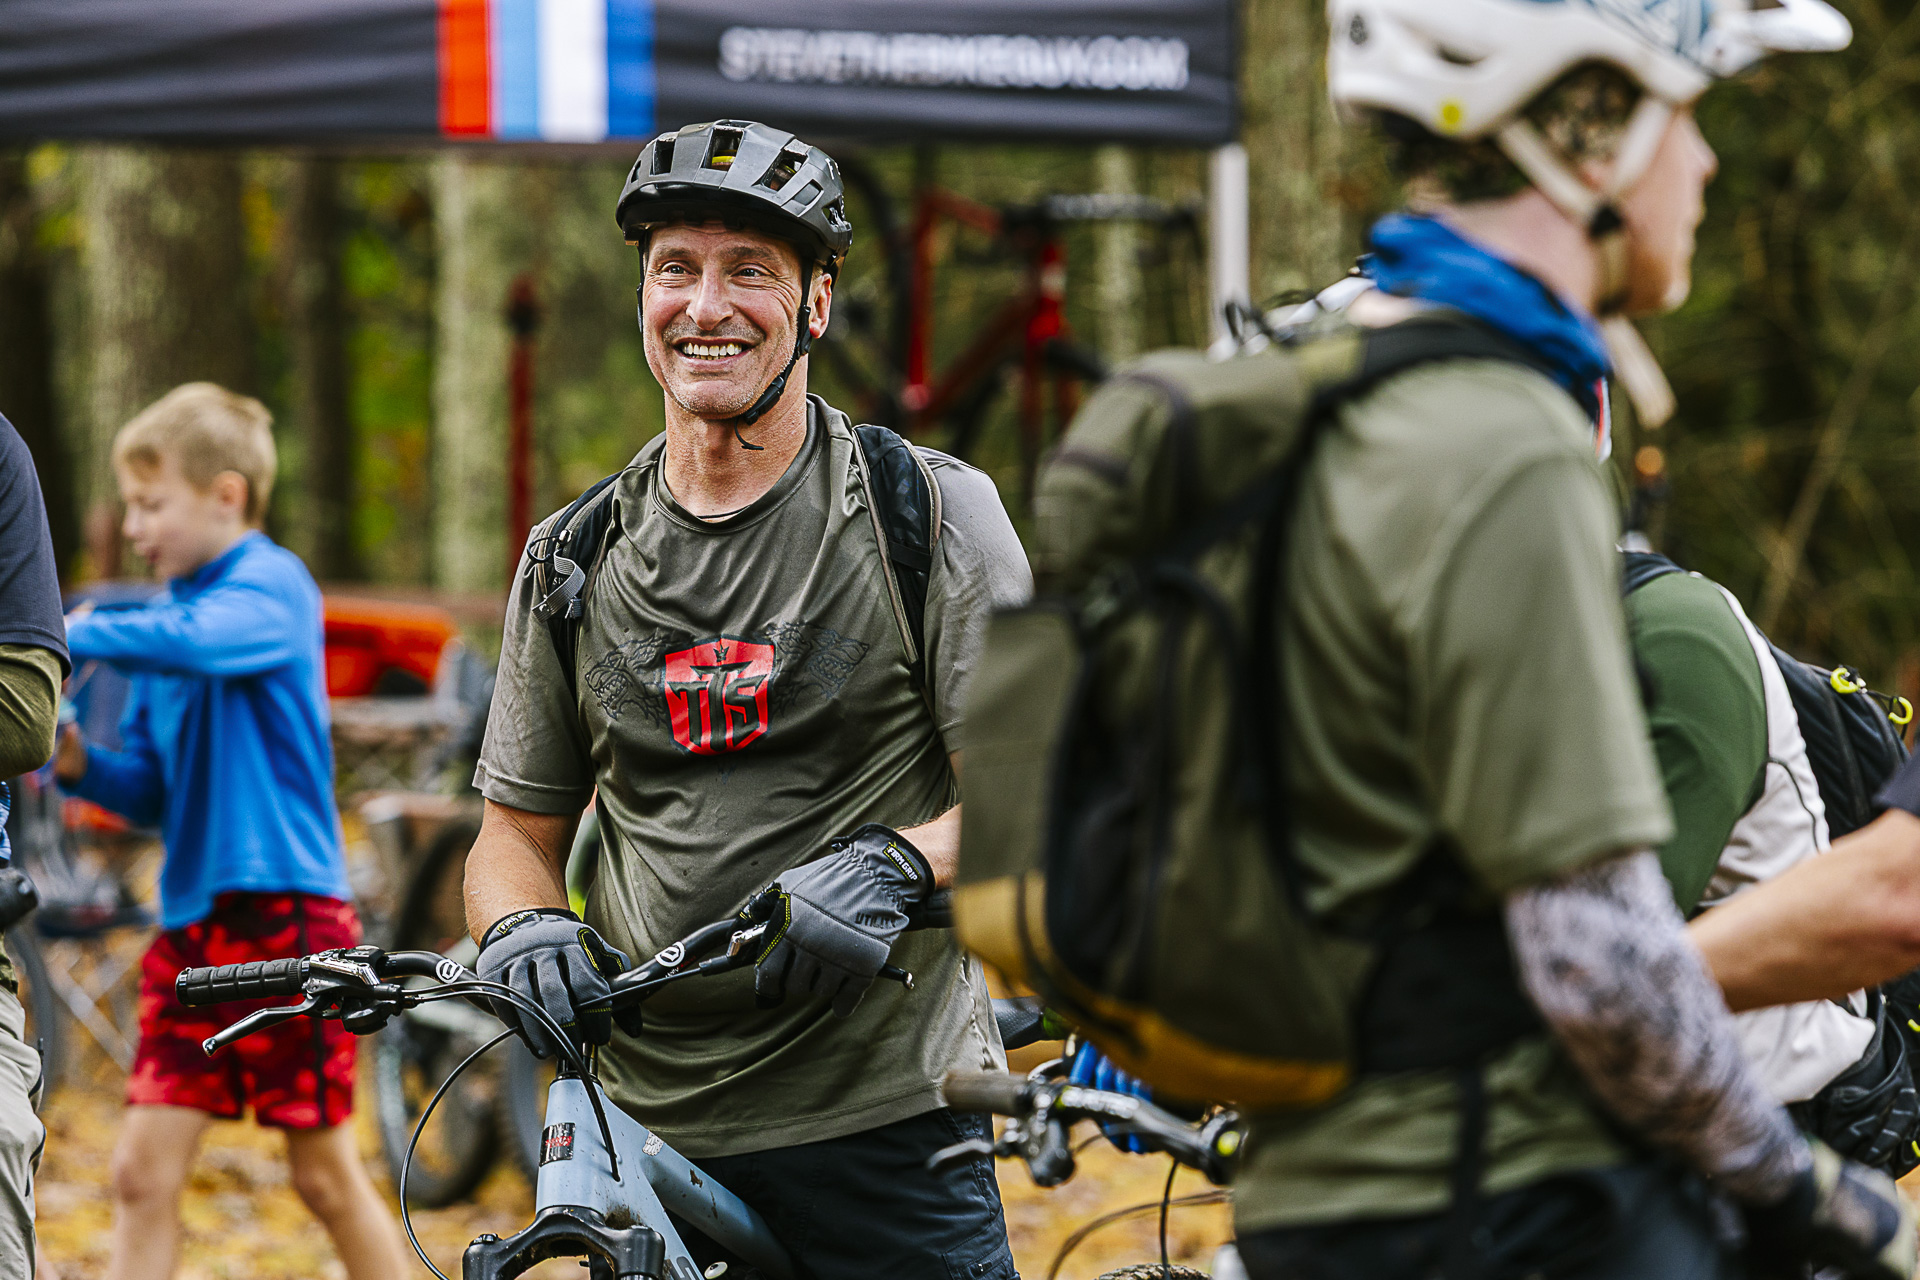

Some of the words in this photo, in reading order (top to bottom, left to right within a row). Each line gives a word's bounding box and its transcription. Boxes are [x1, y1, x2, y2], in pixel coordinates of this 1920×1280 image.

[887, 846, 905, 865] FIRM
[902, 863, 918, 881] GRIP
[855, 911, 896, 928] UTILITY
